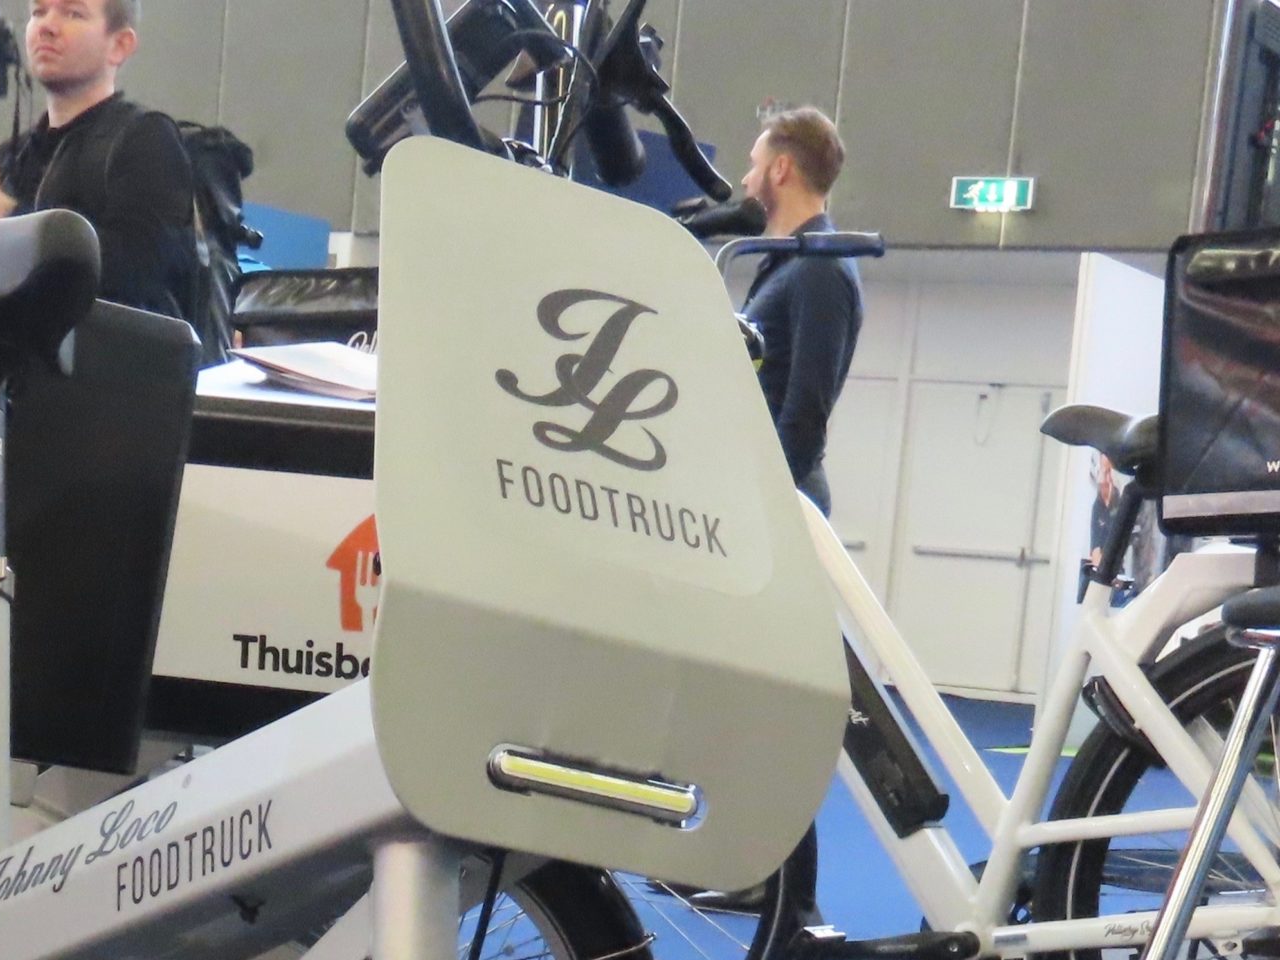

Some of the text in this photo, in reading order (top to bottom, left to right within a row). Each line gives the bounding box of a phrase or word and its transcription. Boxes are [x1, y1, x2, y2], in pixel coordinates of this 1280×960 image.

[495, 458, 728, 558] FOODTRUCK
[85, 799, 178, 864] Loco
[116, 799, 273, 912] FOODTRUCK
